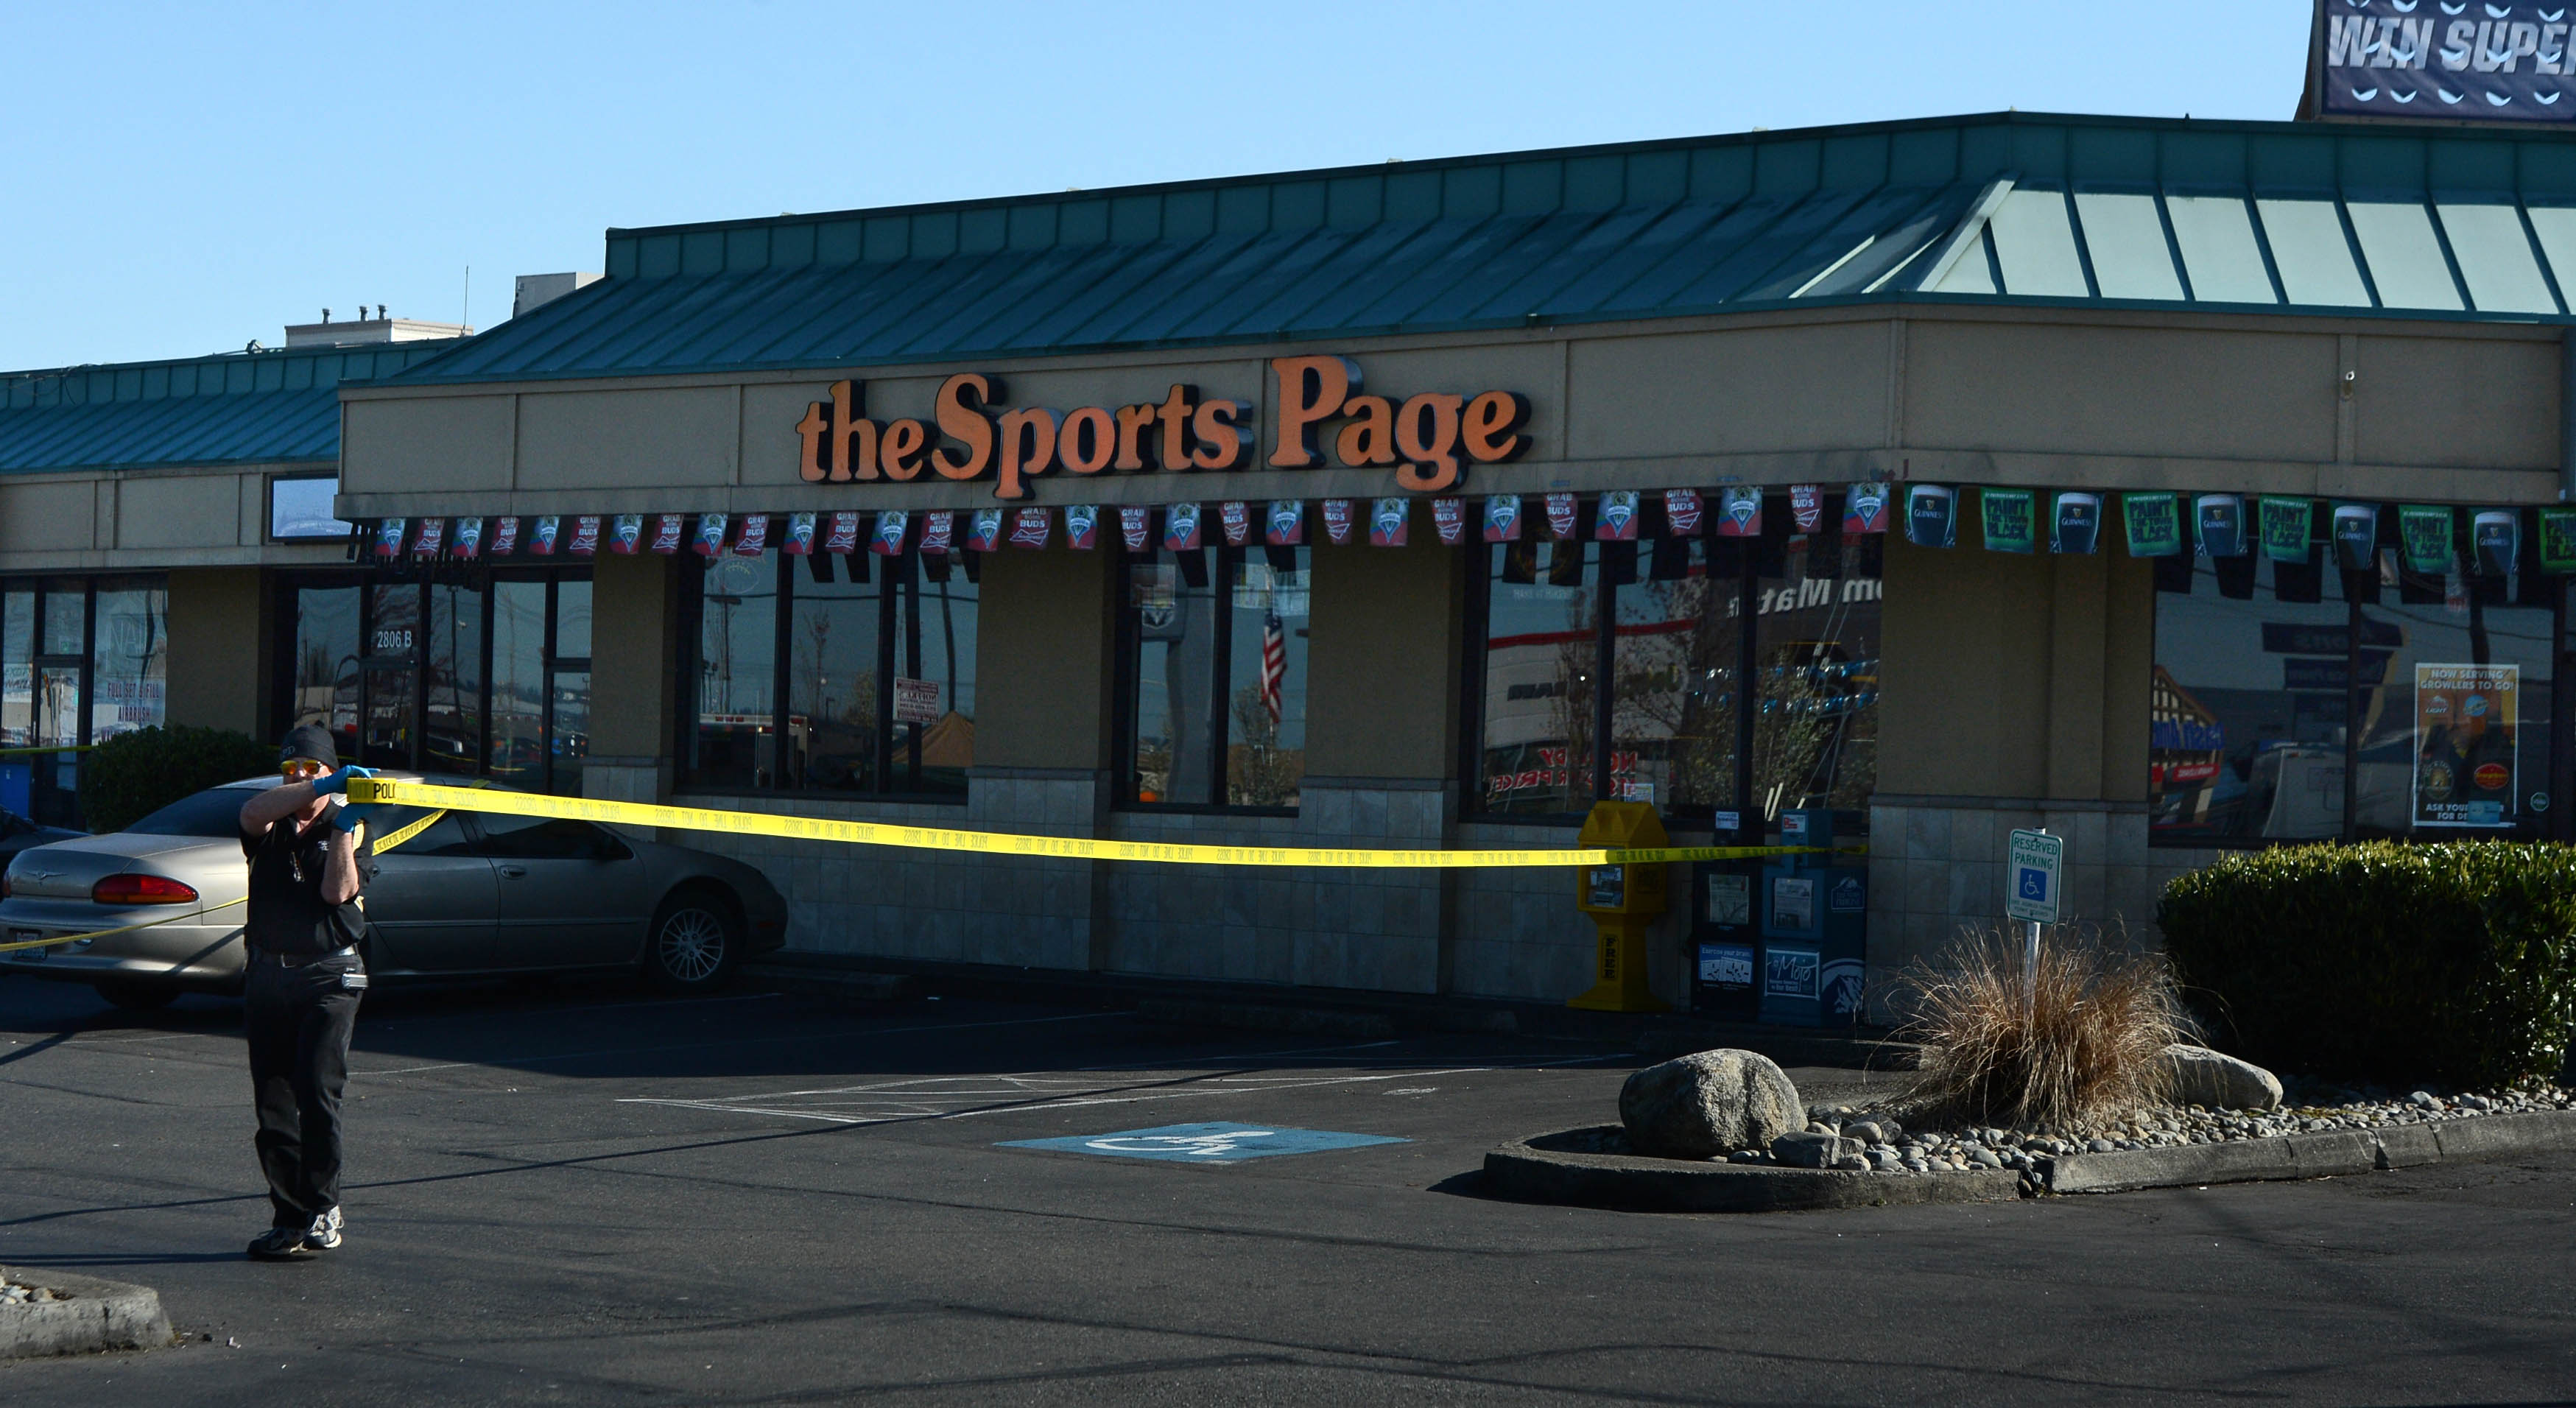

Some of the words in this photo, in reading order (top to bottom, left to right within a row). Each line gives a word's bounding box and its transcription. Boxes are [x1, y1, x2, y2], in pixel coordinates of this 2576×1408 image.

[2328, 15, 2435, 70] WIN
[795, 380, 931, 483] the
[932, 372, 1253, 500] Sports
[1269, 353, 1532, 493] Page
[1791, 485, 1817, 493] GRAB
[1546, 493, 1573, 501] GRAB
[1667, 489, 1696, 498] GRAB
[1224, 502, 1245, 510] GRAB
[1325, 499, 1348, 507] GRAB
[1434, 499, 1460, 507] GRAB
[1791, 499, 1815, 507] BUDS
[1021, 507, 1046, 515] GRAB
[1547, 507, 1571, 515] BUDS
[1667, 503, 1695, 512] BUDS
[837, 513, 856, 521] GRAB
[930, 513, 951, 521] GRAB
[1122, 509, 1144, 517] GRAB
[1325, 513, 1345, 521] BUDS
[1435, 513, 1457, 521] BUDS
[1914, 509, 1945, 519] GUINNESS
[1223, 515, 1244, 524] BUDS
[2061, 517, 2092, 527] GUINNESS
[1019, 520, 1046, 528] BUDS
[1122, 521, 1143, 529] BUDS
[835, 525, 856, 533] BUDS
[377, 630, 401, 649] 2806
[404, 630, 412, 649] B
[2431, 669, 2457, 679] NOW
[2460, 669, 2504, 680] SERVING
[2421, 680, 2475, 690] GROWLERS
[2478, 680, 2493, 690] TO
[2495, 681, 2515, 691] GO!
[108, 683, 122, 698] FULL
[118, 706, 150, 722] AIRBRUSH
[373, 783, 396, 799] POLI
[2426, 803, 2445, 812] ASK
[2437, 812, 2455, 820] FOR
[2013, 837, 2058, 856] RESERVED
[2014, 852, 2053, 870] PARKING
[1604, 937, 1616, 979] FREE
